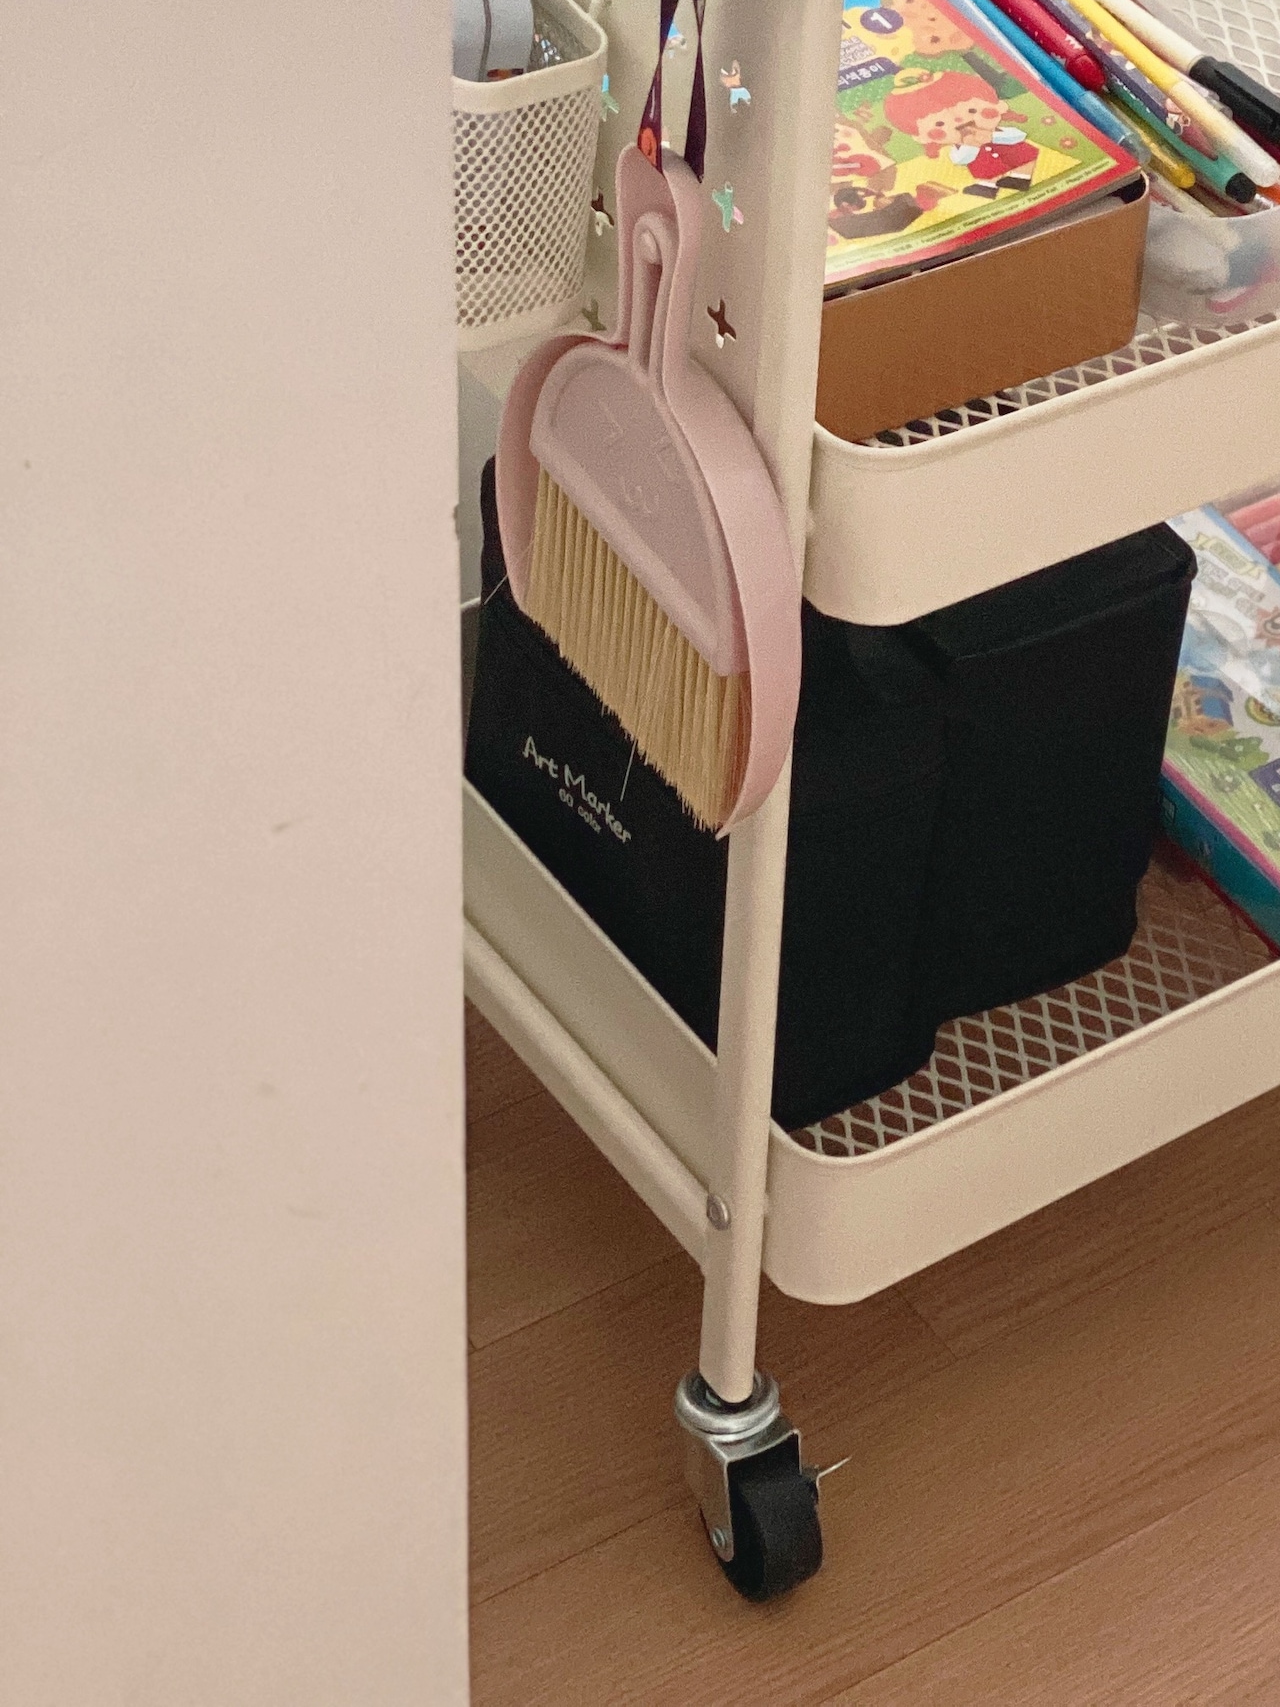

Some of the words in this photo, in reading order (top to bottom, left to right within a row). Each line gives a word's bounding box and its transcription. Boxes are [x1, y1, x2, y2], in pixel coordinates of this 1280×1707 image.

[870, 11, 893, 30] 1
[521, 734, 560, 780] Art
[563, 762, 633, 845] Marker
